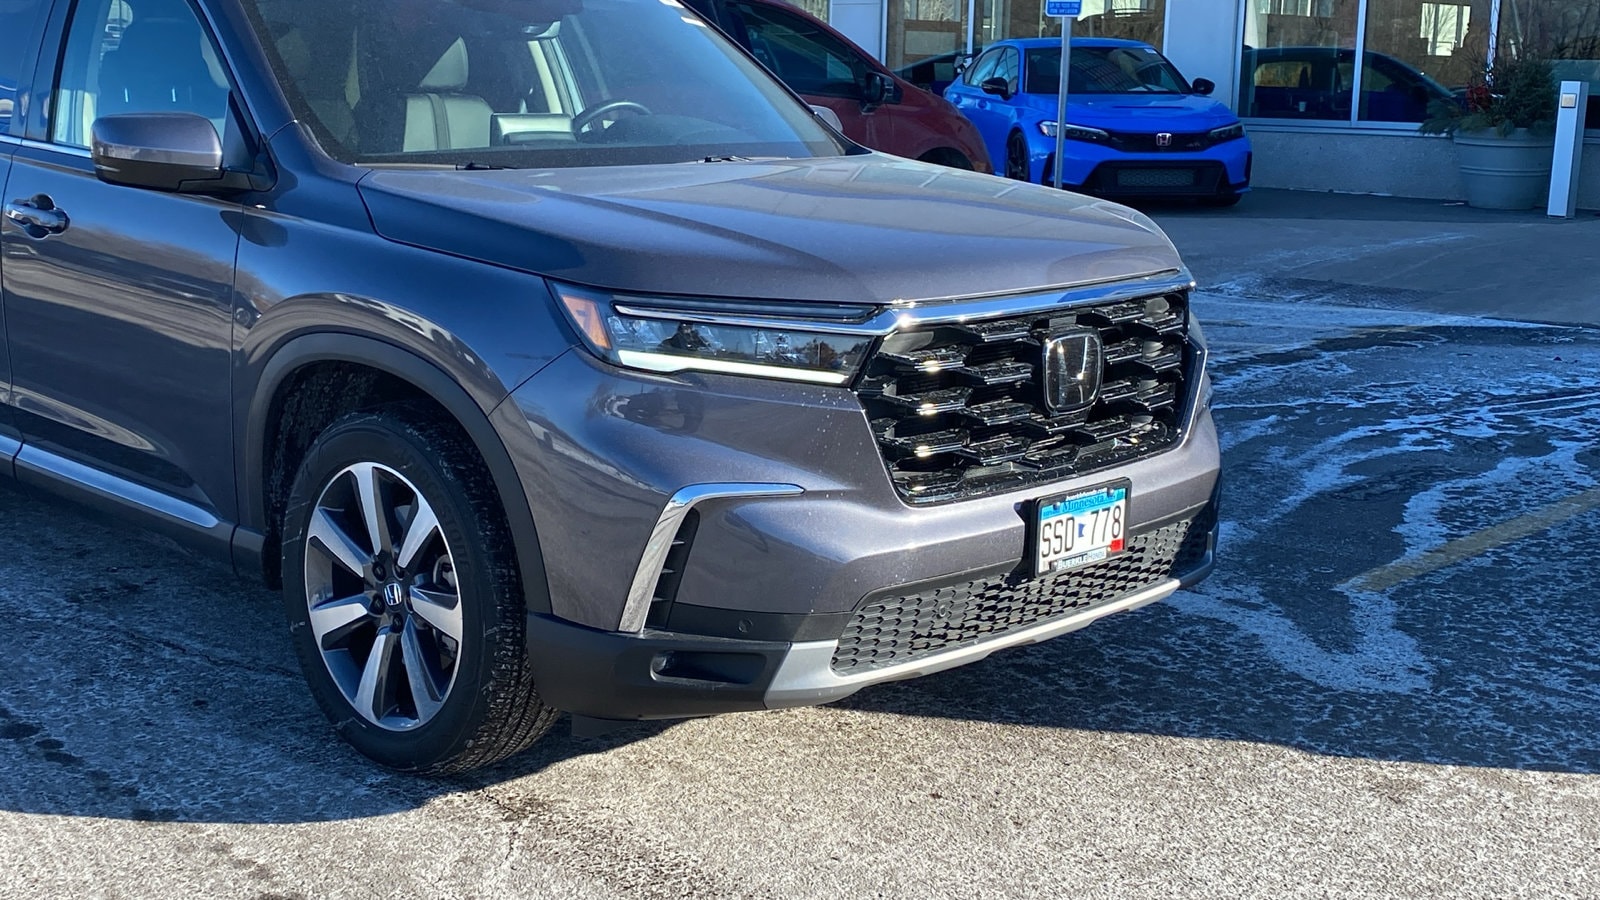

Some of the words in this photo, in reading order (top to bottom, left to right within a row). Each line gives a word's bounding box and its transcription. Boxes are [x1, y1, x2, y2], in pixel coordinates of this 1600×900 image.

[1062, 494, 1104, 512] Minnesota
[1041, 516, 1075, 558] SSD
[1090, 505, 1122, 546] 778
